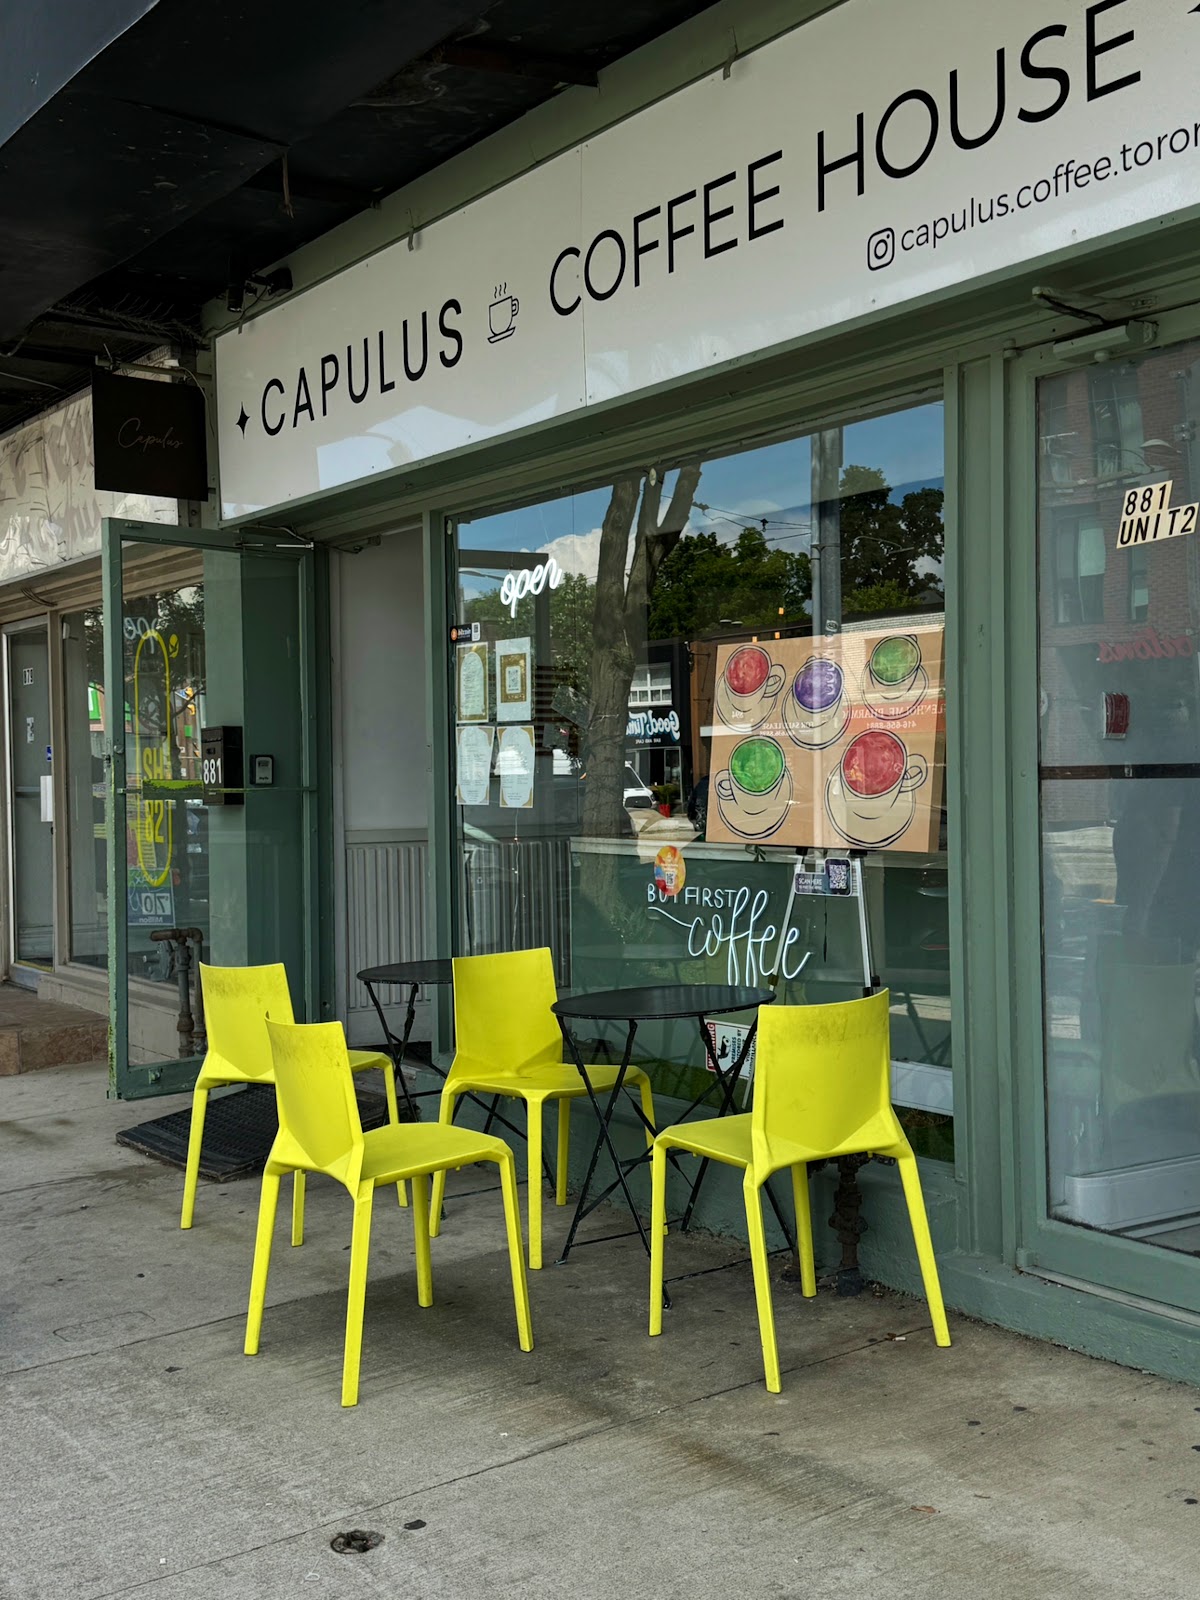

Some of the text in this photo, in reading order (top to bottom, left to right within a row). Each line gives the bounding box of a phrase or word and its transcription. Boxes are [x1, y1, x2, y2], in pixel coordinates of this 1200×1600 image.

[262, 0, 1141, 436] CAPULUS COFFEE HOUSE
[117, 417, 184, 452] Capulus
[1125, 484, 1167, 516] 881
[500, 558, 563, 618] open
[203, 757, 222, 784] 881
[684, 886, 737, 908] FIRST
[687, 887, 814, 987] coffee
